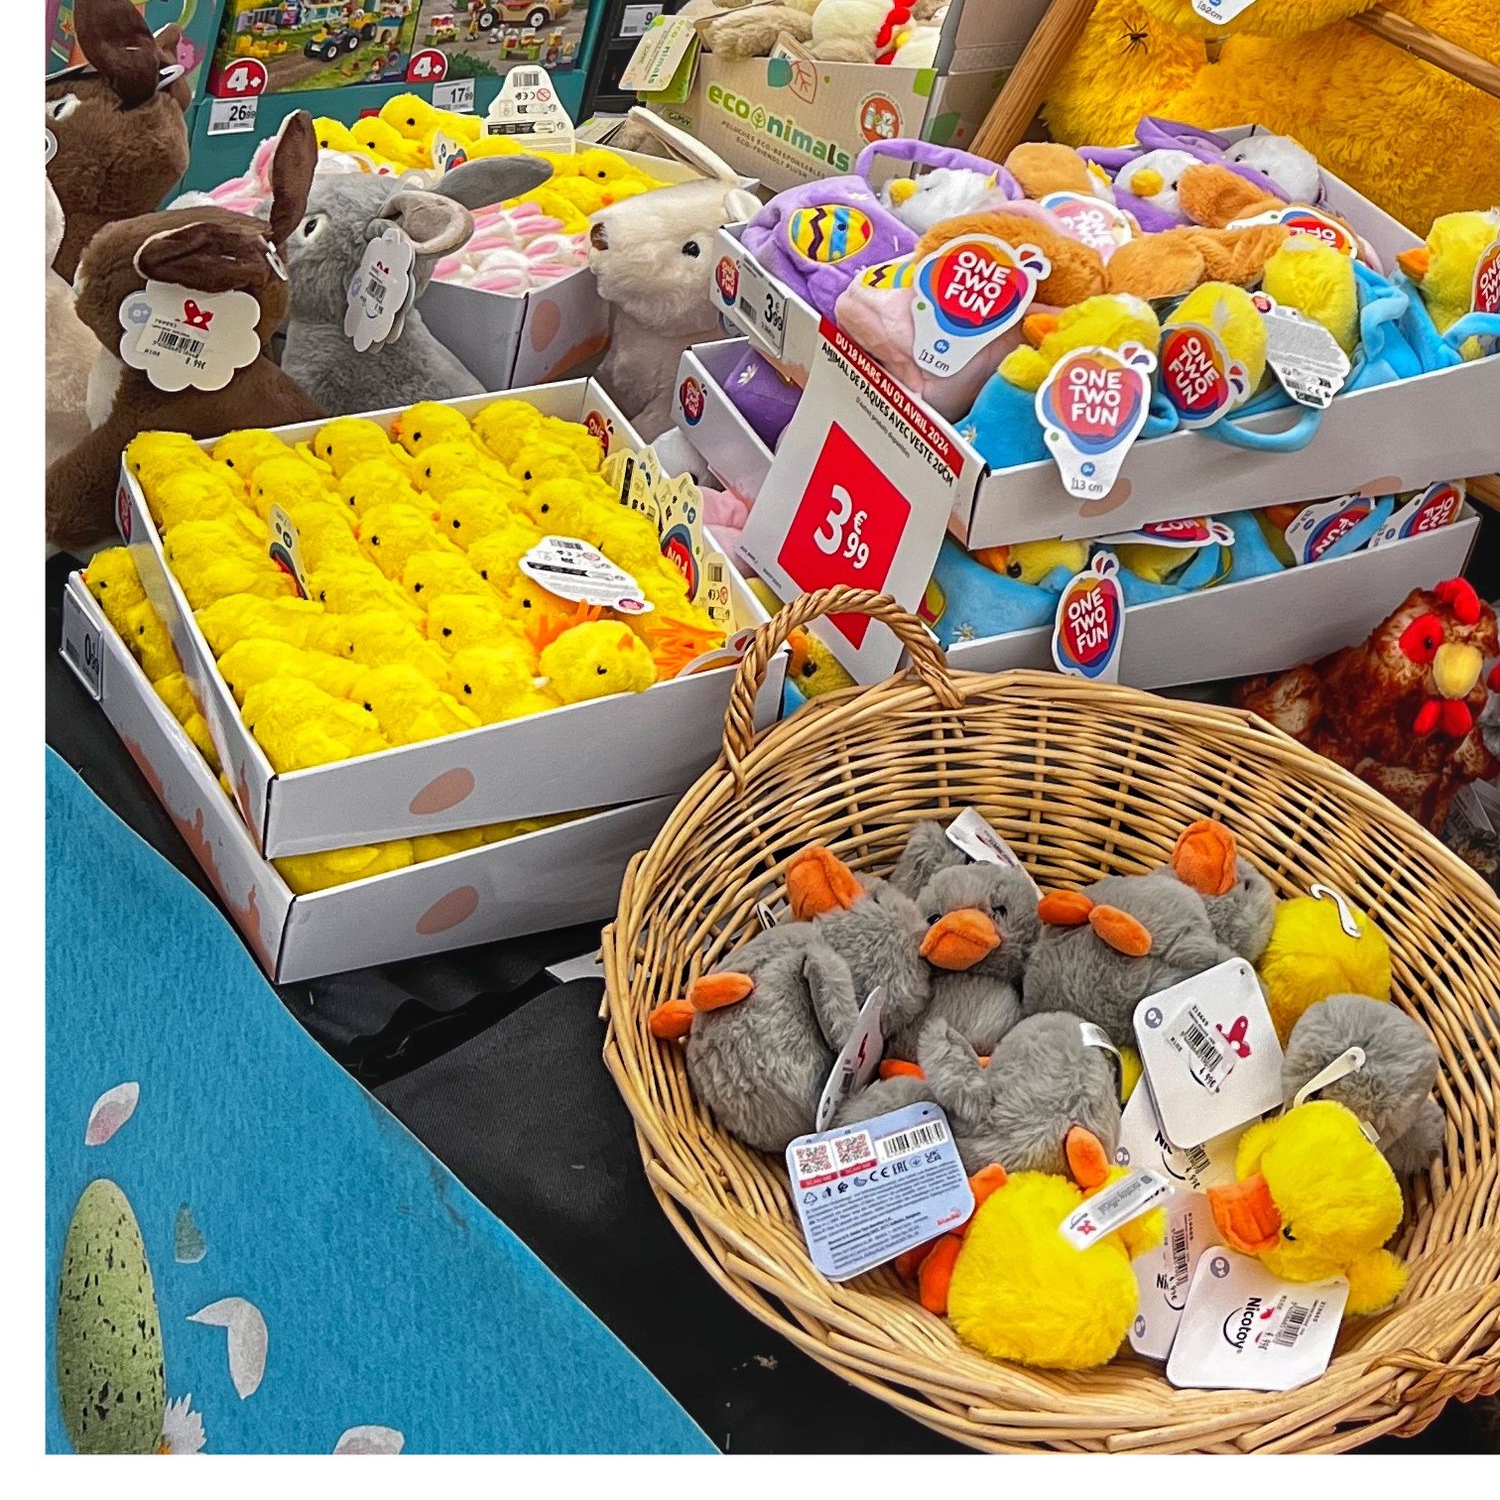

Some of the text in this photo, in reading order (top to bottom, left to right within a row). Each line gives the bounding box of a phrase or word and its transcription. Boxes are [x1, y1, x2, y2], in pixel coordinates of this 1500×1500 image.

[226, 68, 263, 92] 4+
[413, 56, 443, 78] 4+
[953, 265, 1001, 298] TWO
[958, 251, 1011, 286] ONE
[944, 283, 995, 317] FUN
[1069, 367, 1122, 389] ONE
[1177, 345, 1211, 394] TWO
[1187, 336, 1220, 389] ONE
[835, 332, 847, 349] DU
[858, 353, 882, 384] MARS
[881, 377, 894, 396] AU
[893, 388, 905, 406] 01
[904, 400, 929, 434] AVRIL
[928, 425, 949, 455] 2024
[1068, 385, 1121, 407] TWO
[1168, 358, 1199, 405] FUN
[821, 341, 850, 377] ANIMAL
[849, 370, 861, 388] DE
[889, 405, 911, 439] AVEC
[910, 430, 934, 465] VESTE
[1071, 403, 1119, 426] FUN
[1068, 587, 1104, 620] ONE
[1071, 606, 1106, 636] TWO
[1076, 620, 1108, 655] FUN
[1236, 1296, 1262, 1349] Nicotoy
